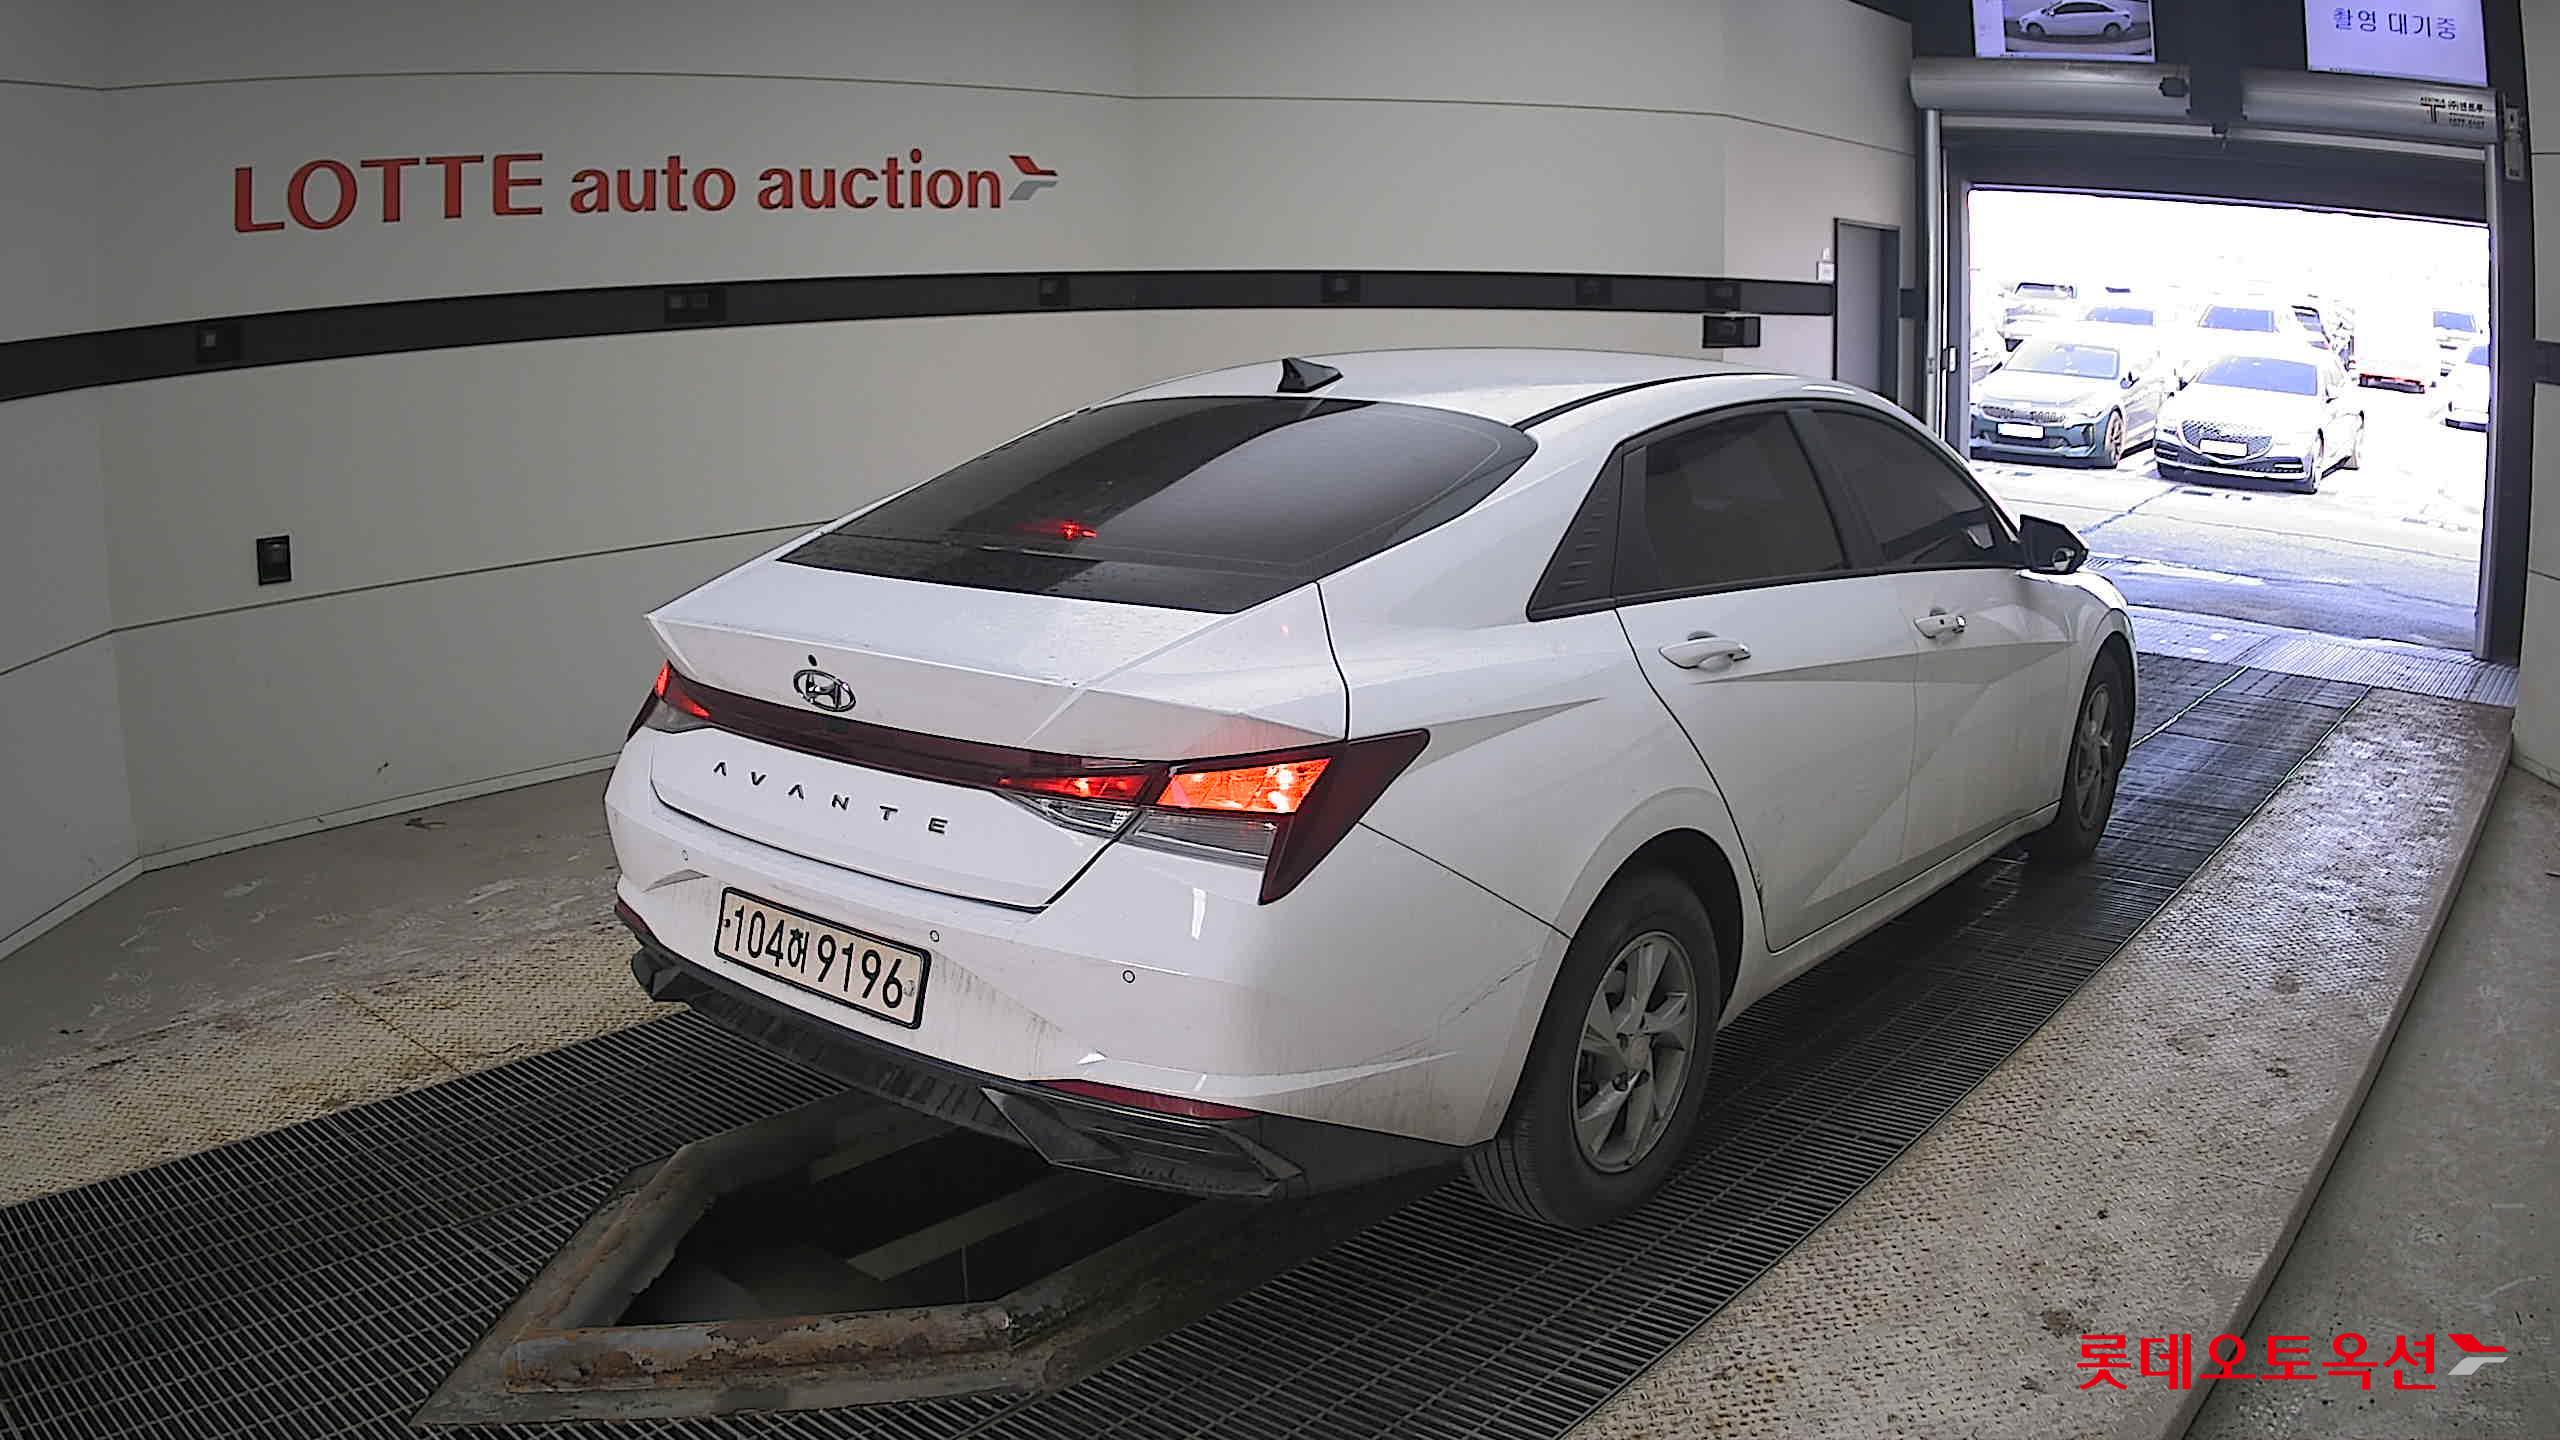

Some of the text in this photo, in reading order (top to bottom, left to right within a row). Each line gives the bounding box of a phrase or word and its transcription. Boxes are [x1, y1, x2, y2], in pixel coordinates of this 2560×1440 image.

[2333, 6, 2457, 41] 촬영 대기중
[235, 149, 1003, 233] LOTTE auto auction
[712, 760, 949, 836] AVANTE
[733, 904, 904, 1010] 104허 9196
